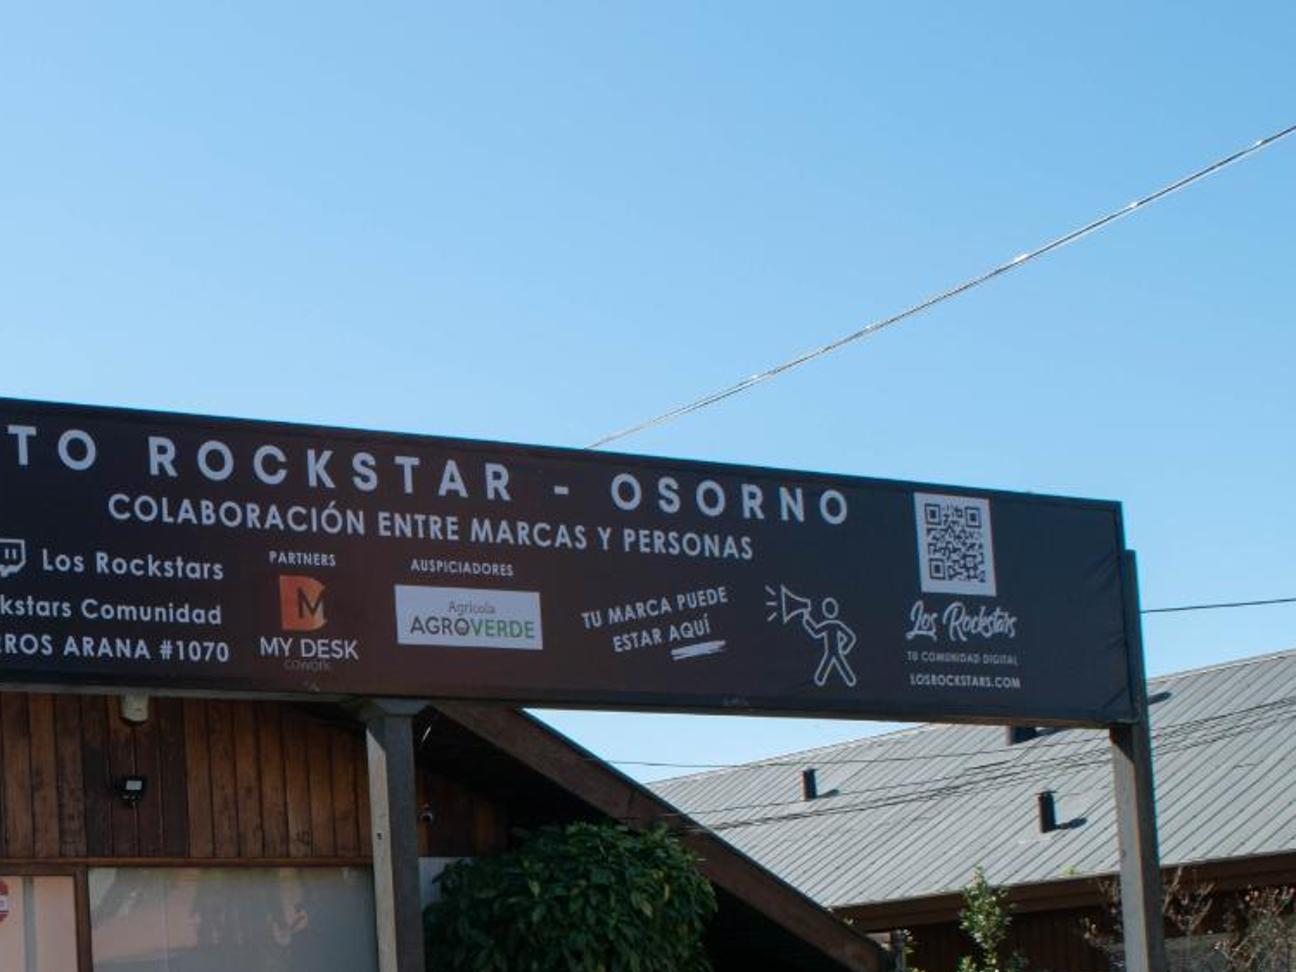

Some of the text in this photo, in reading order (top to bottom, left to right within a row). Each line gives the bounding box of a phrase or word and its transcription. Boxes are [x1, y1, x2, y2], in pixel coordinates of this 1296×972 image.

[148, 437, 511, 501] ROCKSTAR
[554, 485, 569, 496] -
[611, 473, 847, 525] OSORNO
[107, 493, 754, 561] COLABORACIÓN ENTRE MARCAS Y PERSONAS
[41, 548, 225, 581] Los Rockstars
[268, 550, 336, 567] PARTNERS
[410, 558, 514, 577] AUSPICIADORES
[80, 597, 223, 626] Comunidad
[581, 586, 728, 629] TU MARCA PUEDE
[410, 616, 535, 639] AGROVERDE
[612, 613, 711, 652] ESTAR AQUÍ
[62, 635, 151, 661] ARANA
[159, 637, 231, 664] #1070
[260, 636, 359, 660] MY DESK
